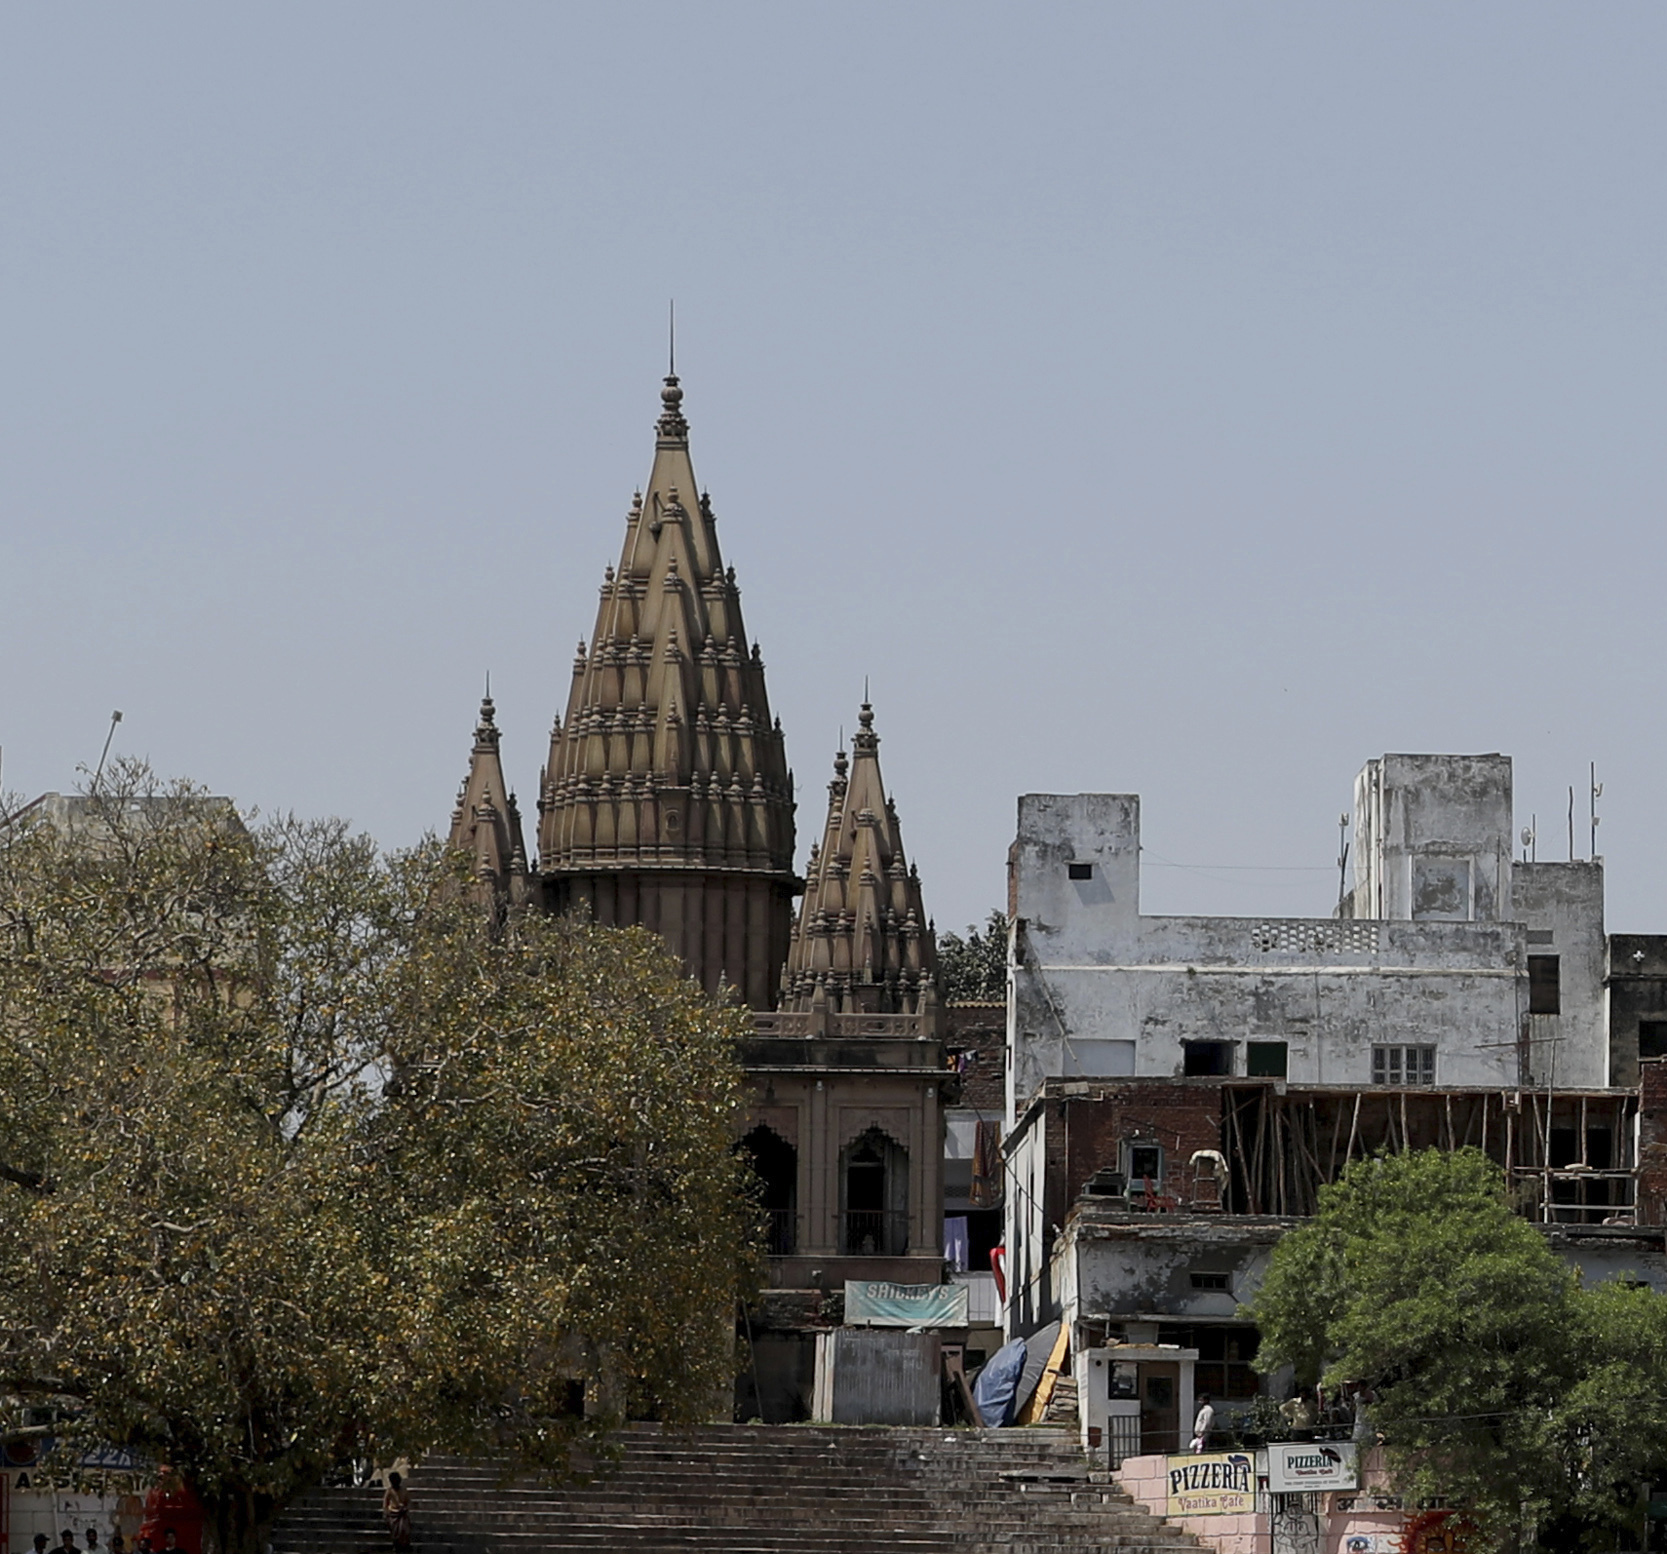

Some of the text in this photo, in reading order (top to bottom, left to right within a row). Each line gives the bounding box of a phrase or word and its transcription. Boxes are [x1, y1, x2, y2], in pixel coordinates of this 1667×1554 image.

[1287, 1455, 1333, 1469] PIZZERIA
[1170, 1462, 1250, 1495] PIZZERIA
[1178, 1495, 1217, 1511] Vaatika
